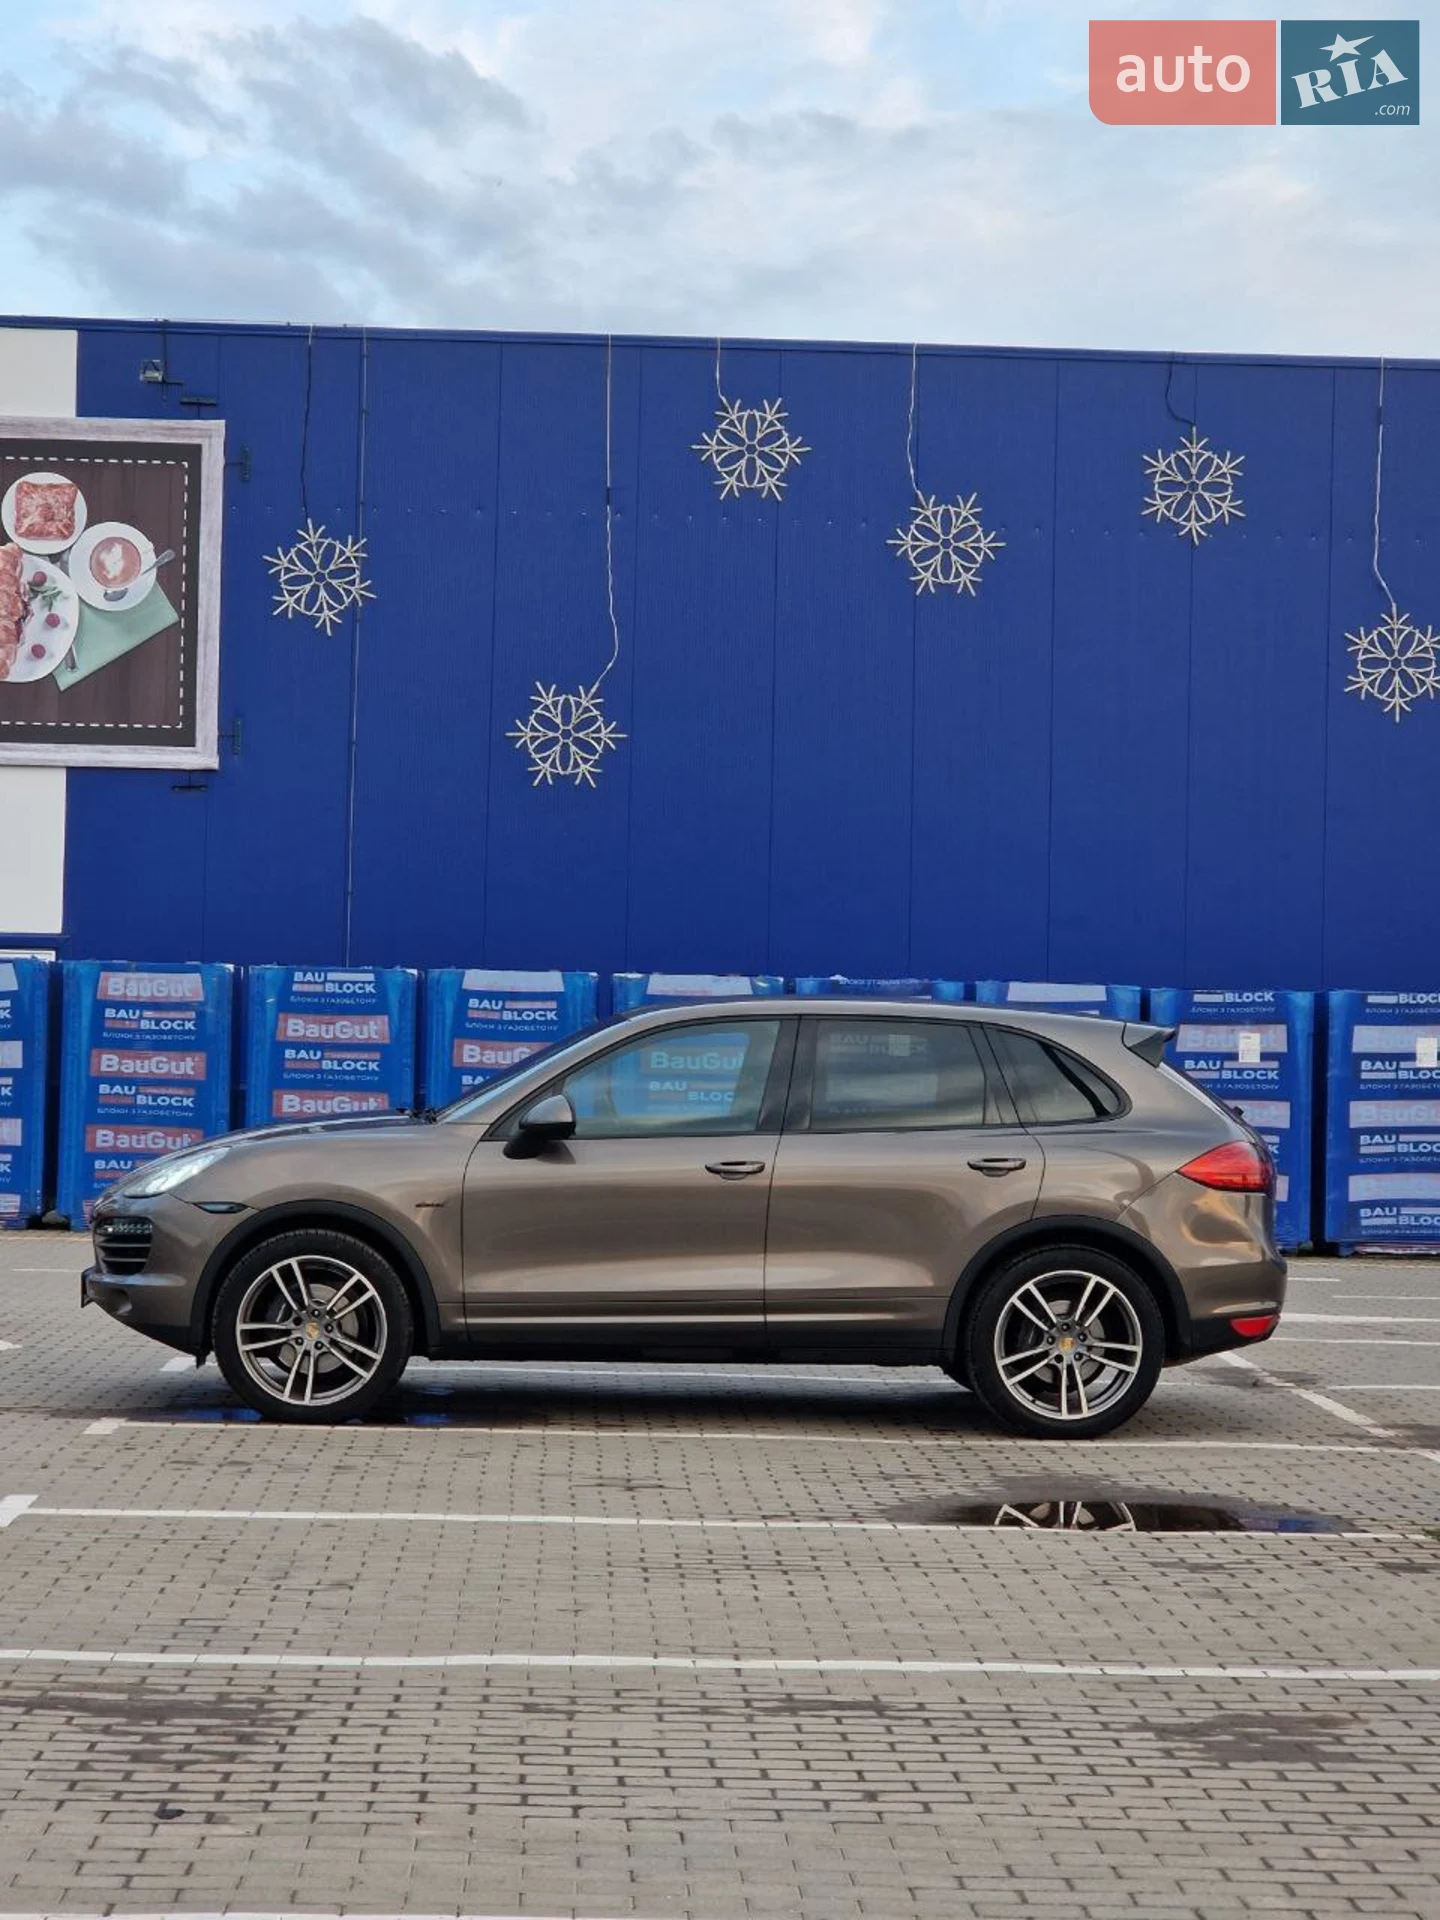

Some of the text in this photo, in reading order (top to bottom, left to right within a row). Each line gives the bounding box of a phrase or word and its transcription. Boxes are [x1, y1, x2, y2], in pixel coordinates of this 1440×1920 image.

[293, 971, 325, 982] BAU
[107, 977, 194, 997] BauGut
[325, 982, 377, 993] BLOCK
[1225, 992, 1274, 1003] BLOCK
[1398, 993, 1440, 1004] BLOC
[468, 998, 503, 1010] BAU
[104, 1008, 140, 1019] BAU
[502, 1010, 558, 1021] BLOCK
[140, 1019, 196, 1030] BLOCK
[287, 1018, 379, 1039] BauGut
[284, 1049, 322, 1060] BAU
[100, 1054, 195, 1075] BauGut
[321, 1060, 380, 1071] BLOCK
[1184, 1060, 1221, 1070] BAU
[1360, 1060, 1397, 1070] BAU
[1221, 1069, 1279, 1080] BLOCK
[1397, 1070, 1440, 1080] BLOC
[98, 1084, 136, 1095] BAU
[649, 1081, 687, 1092] BAU
[135, 1094, 195, 1107] BLOCK
[687, 1091, 734, 1102] BLOC
[1359, 1134, 1397, 1145] BAU
[1397, 1142, 1440, 1153] BLOC
[93, 1160, 133, 1170] BAU
[1359, 1207, 1398, 1218] BAU
[1398, 1215, 1440, 1225] BLOC
